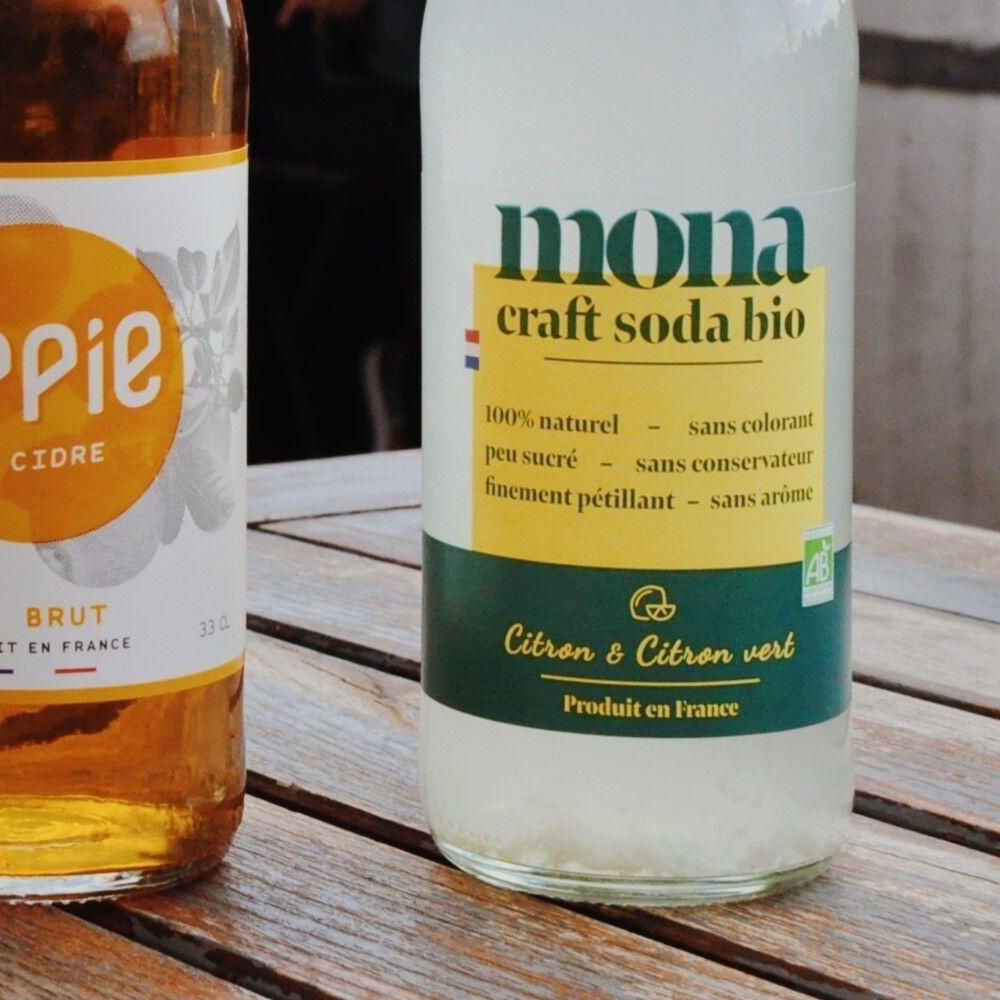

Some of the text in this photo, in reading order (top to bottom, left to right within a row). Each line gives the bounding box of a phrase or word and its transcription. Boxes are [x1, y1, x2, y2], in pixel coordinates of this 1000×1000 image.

[494, 203, 811, 290] mona
[496, 294, 806, 344] craft soda bio
[485, 404, 535, 429] 100%
[539, 413, 619, 435] naturel
[688, 419, 737, 436] sans
[741, 410, 814, 434] colorant
[11, 442, 105, 472] CIDRE
[485, 444, 518, 466] peu
[521, 448, 578, 469] sucré
[635, 457, 686, 473] sans
[691, 449, 814, 473] conservateur
[485, 475, 573, 506] finement
[577, 487, 676, 514] pétillant
[710, 492, 757, 510] sans
[760, 484, 814, 507] arôme
[26, 604, 107, 627] BRUT
[199, 618, 216, 638] 33
[28, 641, 51, 654] EN
[62, 637, 131, 652] FRANCE
[503, 623, 796, 667] Citron & Citron vert
[563, 694, 740, 718] Produit en France
